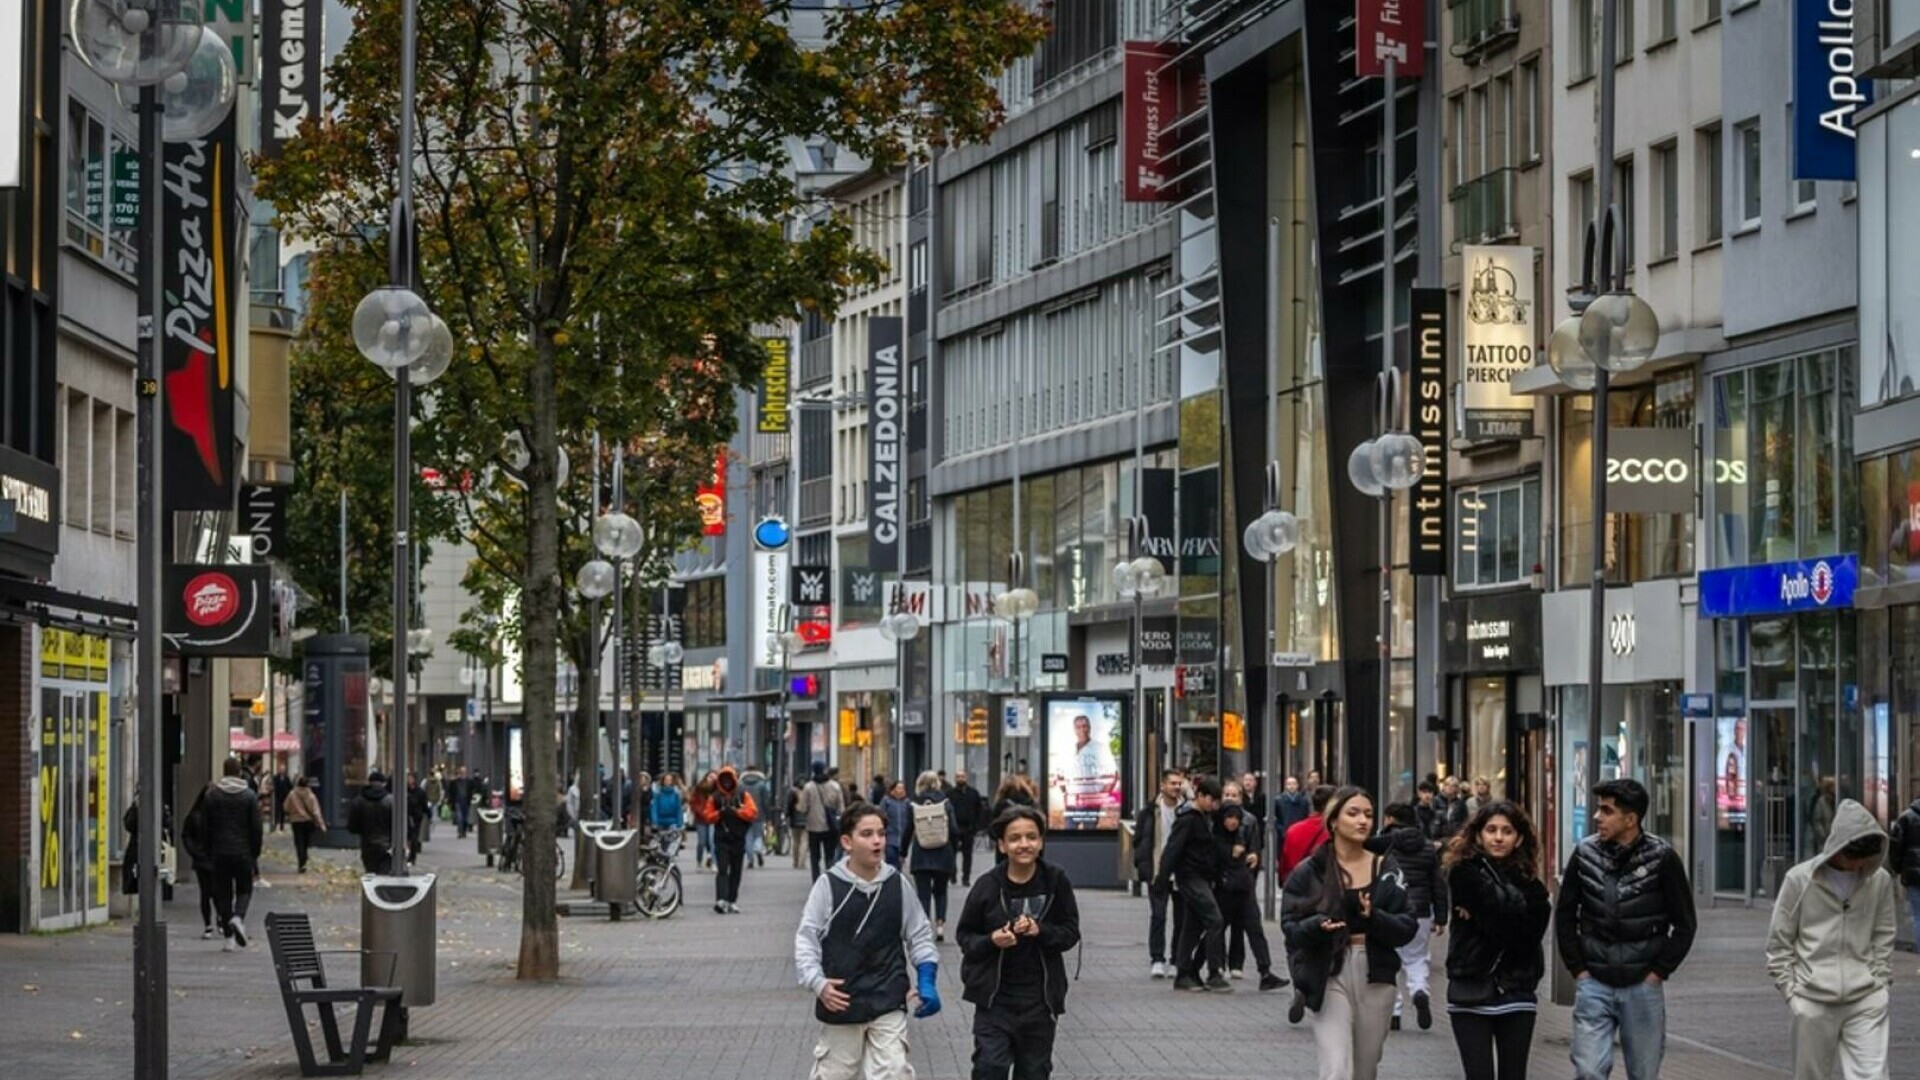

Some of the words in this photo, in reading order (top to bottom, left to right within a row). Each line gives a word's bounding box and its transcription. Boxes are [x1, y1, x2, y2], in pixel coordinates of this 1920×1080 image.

[163, 139, 209, 209] Hu
[164, 216, 216, 355] Pizza
[760, 338, 786, 432] Fahrschule
[1467, 345, 1531, 363] TATTOO
[875, 345, 897, 544] CALZEDONIA
[1418, 312, 1441, 551] intimissimi
[1607, 459, 1688, 483] ecco
[1781, 573, 1809, 606] Apollo
